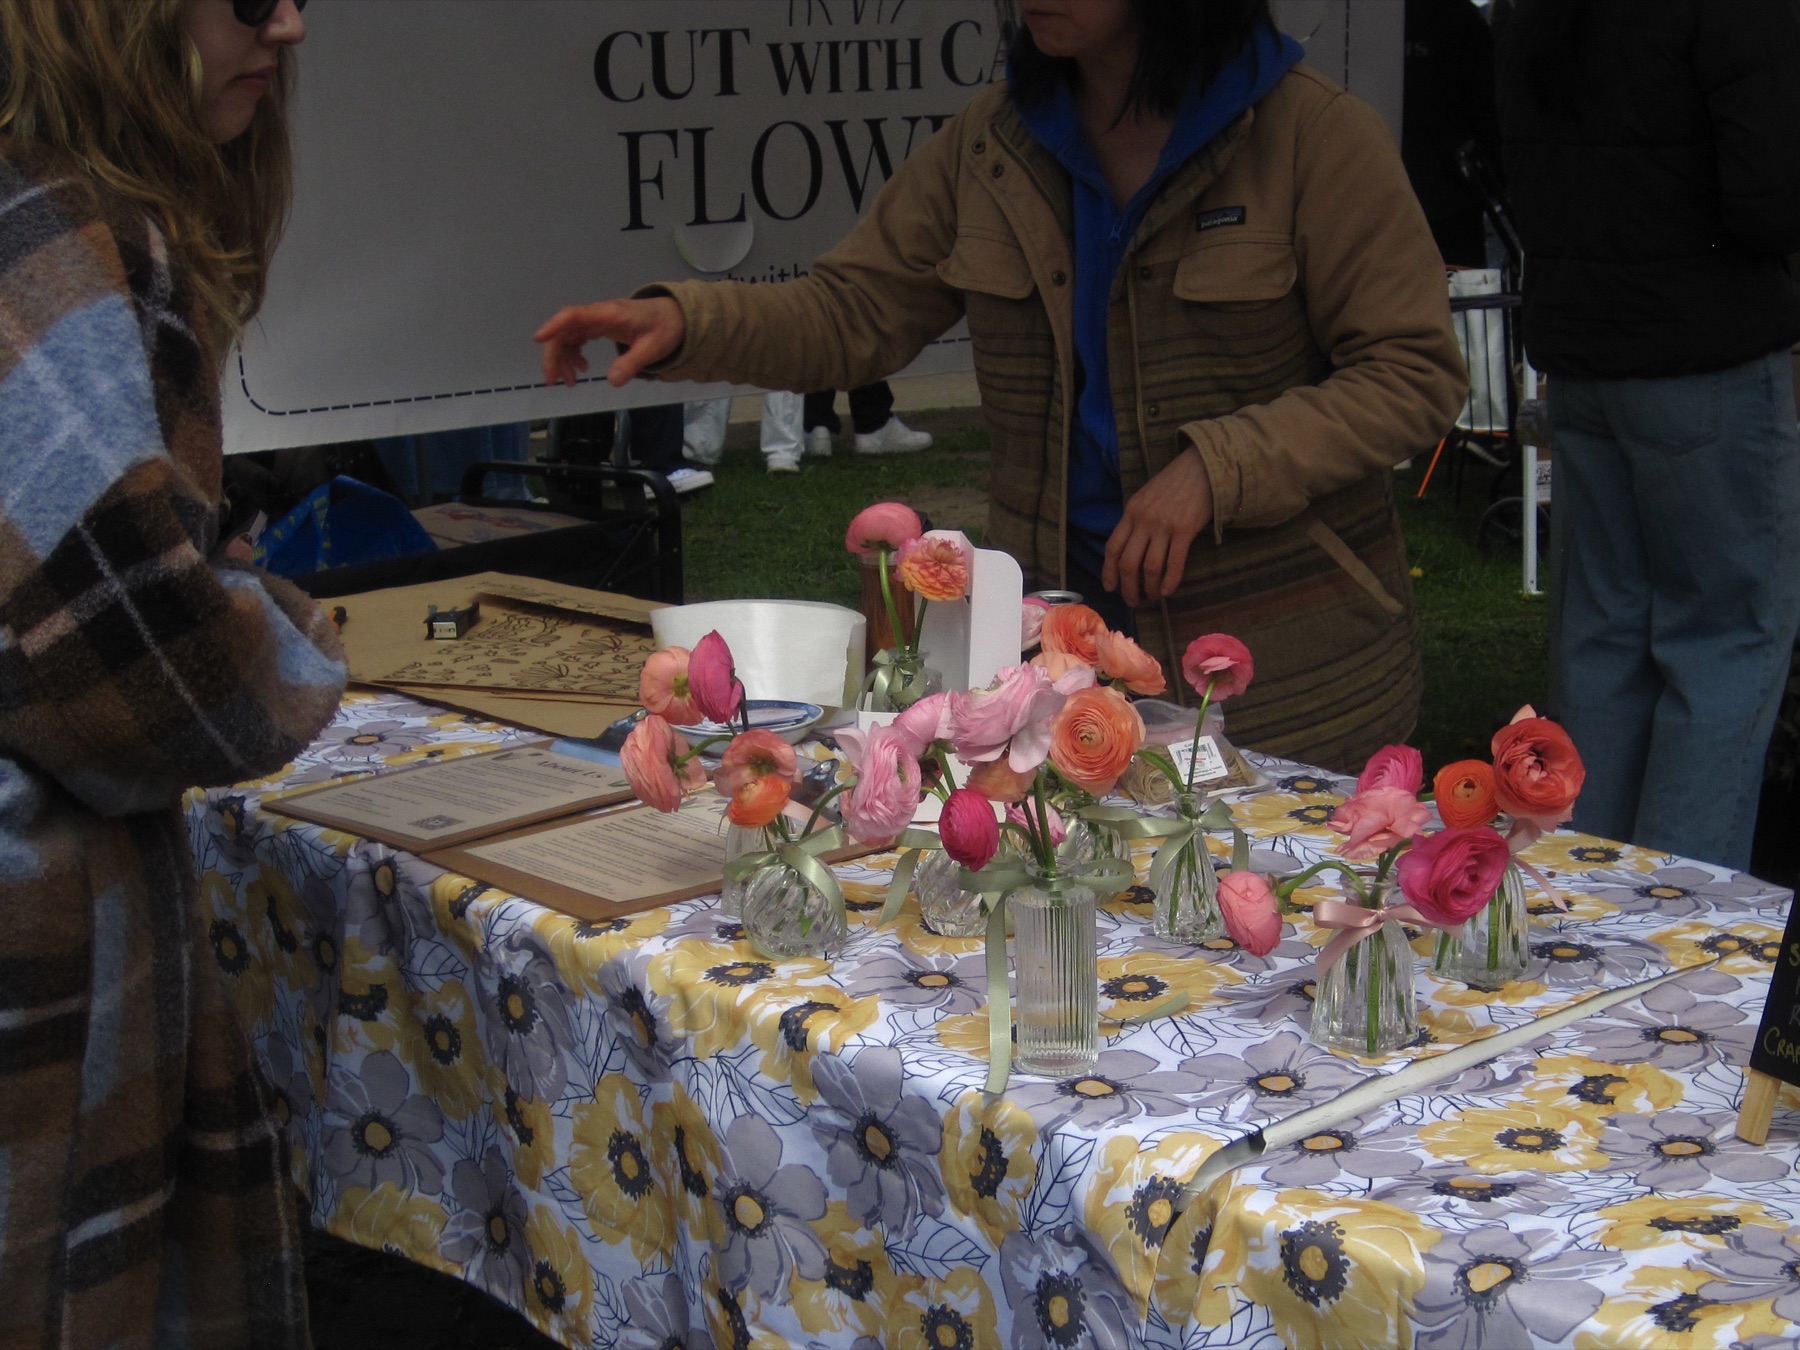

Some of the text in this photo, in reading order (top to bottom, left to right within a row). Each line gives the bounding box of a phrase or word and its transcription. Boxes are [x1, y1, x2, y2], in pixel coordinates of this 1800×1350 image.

[594, 28, 750, 103] CUT
[767, 37, 923, 96] WITH
[618, 114, 956, 231] FLOW
